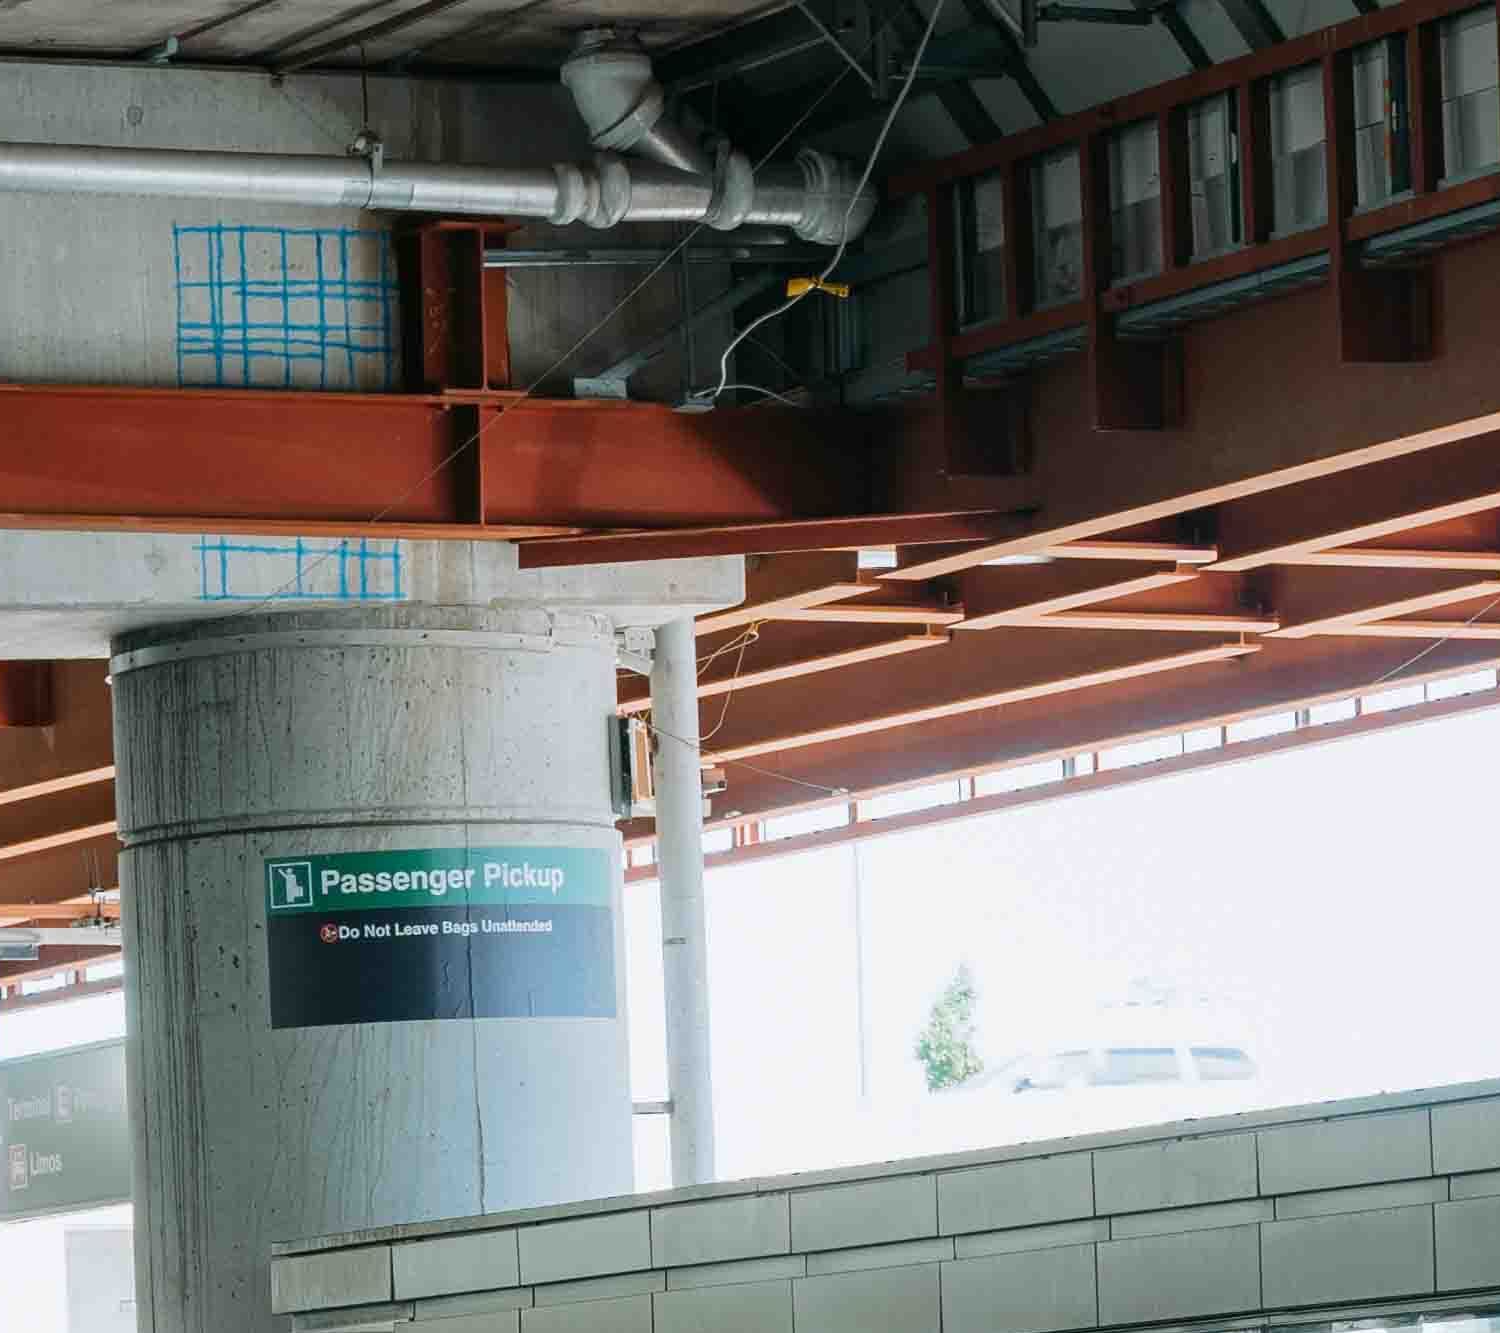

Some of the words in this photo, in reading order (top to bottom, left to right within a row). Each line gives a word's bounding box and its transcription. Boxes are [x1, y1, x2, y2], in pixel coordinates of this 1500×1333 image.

[320, 868, 475, 895] Passenger
[484, 863, 564, 893] Pickup
[339, 925, 360, 940] Do
[364, 923, 391, 939] Not
[394, 921, 439, 937] Leave
[443, 920, 478, 936] Bags
[482, 919, 553, 934] Unattended
[30, 1152, 63, 1177] Limos
